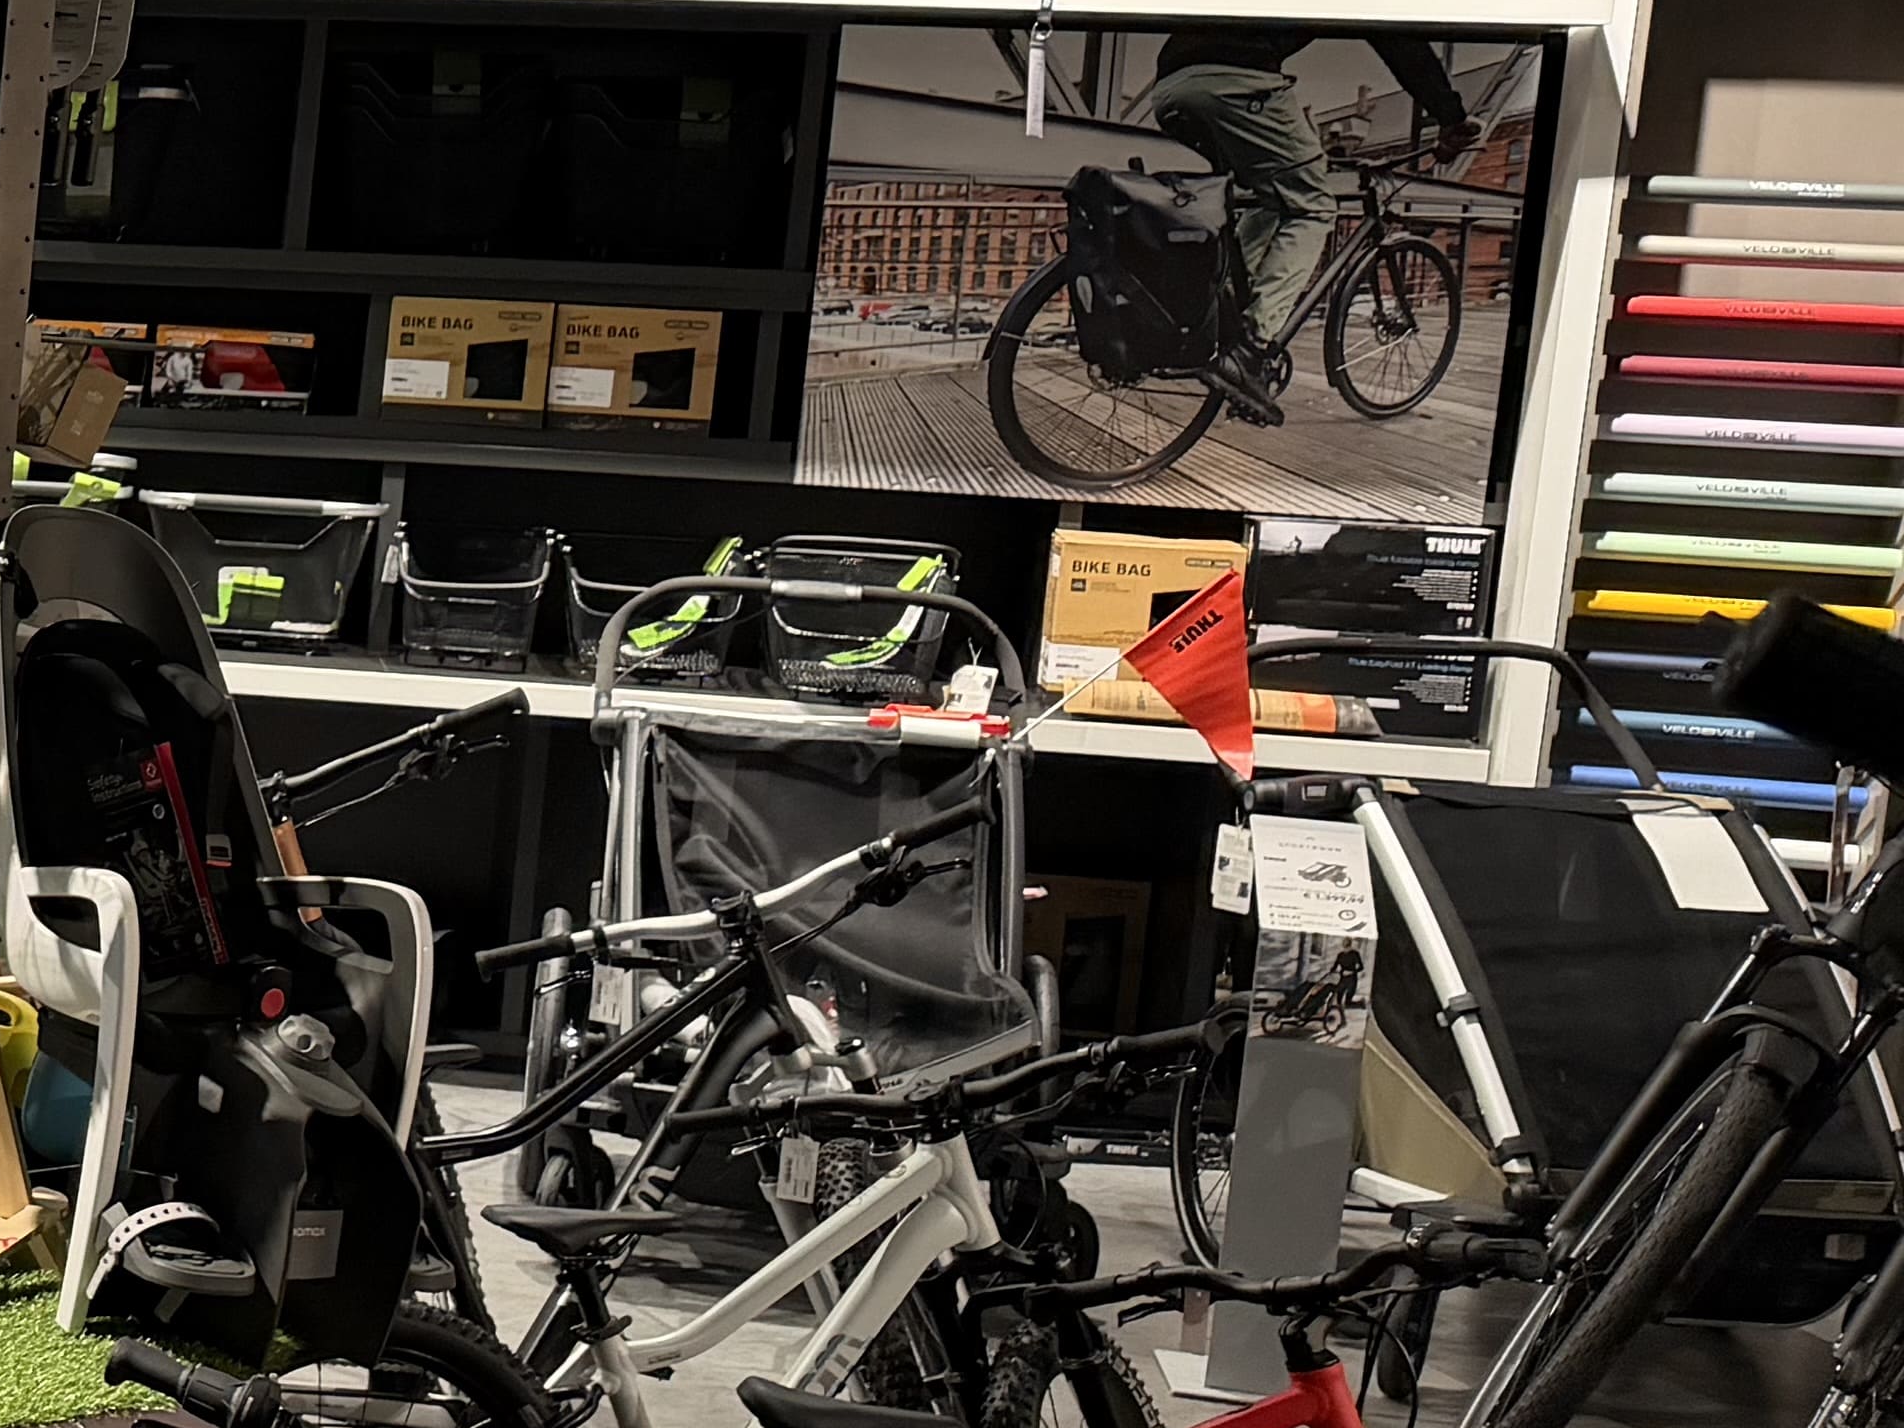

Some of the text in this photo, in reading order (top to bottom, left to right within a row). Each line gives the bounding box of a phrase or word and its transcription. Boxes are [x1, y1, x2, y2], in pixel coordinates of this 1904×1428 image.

[400, 316, 474, 331] BIKE BAG
[566, 323, 640, 339] BIKE BAG
[1425, 537, 1486, 554] THULE
[1072, 560, 1152, 577] BIKE BAG
[1168, 609, 1225, 653] THULE
